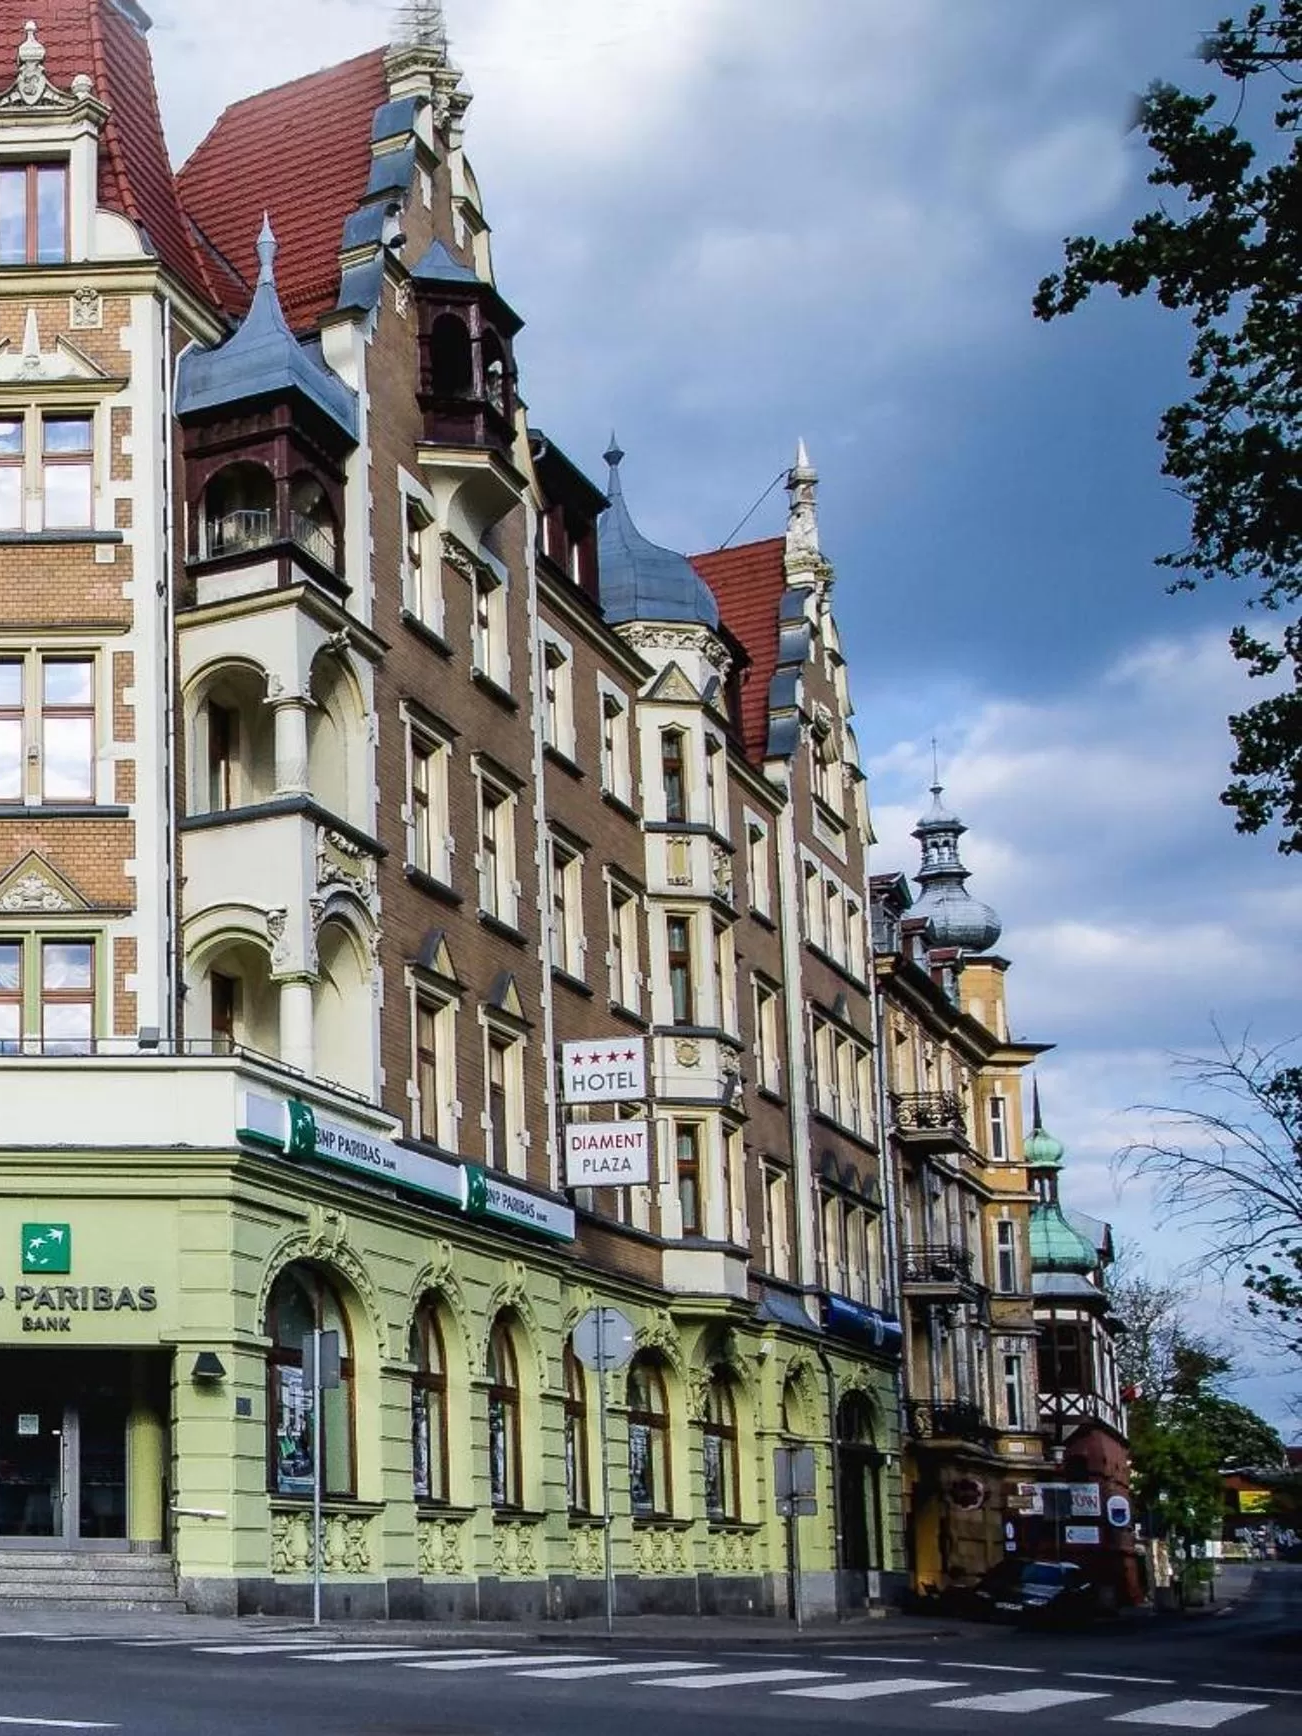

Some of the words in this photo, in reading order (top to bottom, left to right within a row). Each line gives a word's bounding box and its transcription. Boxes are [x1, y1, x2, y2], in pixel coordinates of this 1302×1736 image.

[572, 1071, 637, 1092] HOTEL
[338, 1135, 381, 1165] PARIBAS
[572, 1133, 643, 1150] DIAMENT
[583, 1158, 632, 1173] PLAZA
[502, 1193, 535, 1218] PARIBAS
[15, 1285, 158, 1312] PARIBAS
[21, 1315, 71, 1332] BANK
